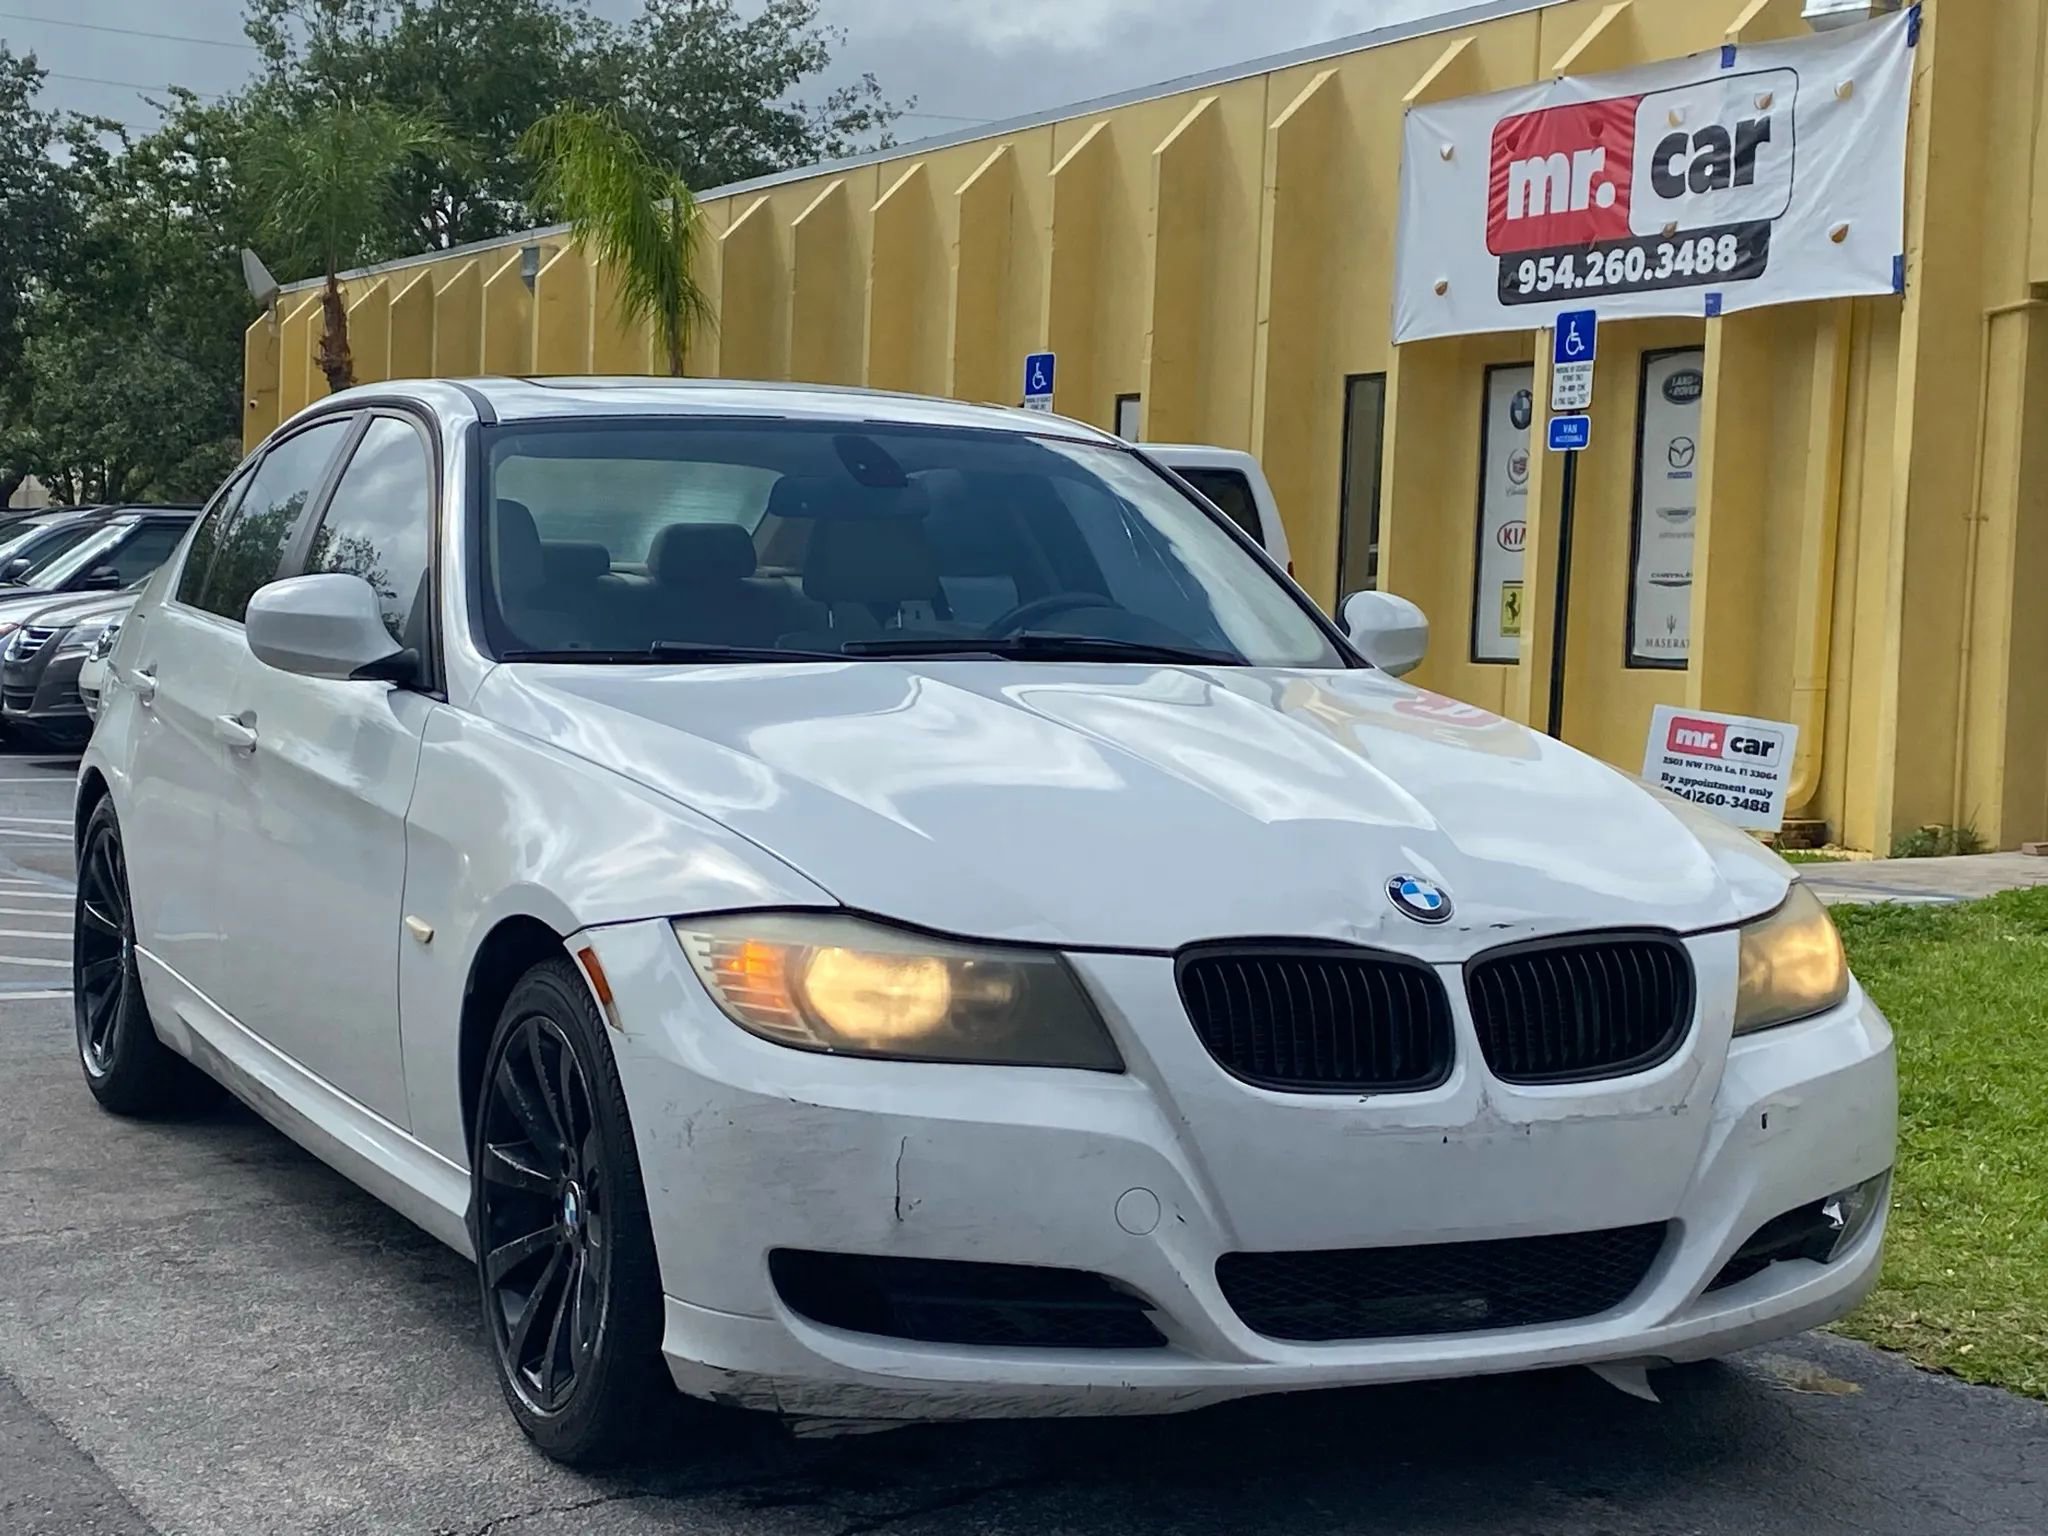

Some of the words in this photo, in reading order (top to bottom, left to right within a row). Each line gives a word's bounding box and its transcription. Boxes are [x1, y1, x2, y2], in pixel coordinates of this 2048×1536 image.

[1506, 145, 1617, 221] mr.
[1650, 114, 1771, 200] car
[1517, 233, 1738, 295] 954.260.3488
[1563, 423, 1578, 434] VAN
[1675, 728, 1718, 750] mr.
[1730, 735, 1775, 757] car
[1685, 759, 1703, 770] NW
[1661, 772, 1676, 784] By
[1678, 776, 1746, 793] appointment
[1749, 786, 1773, 799] only
